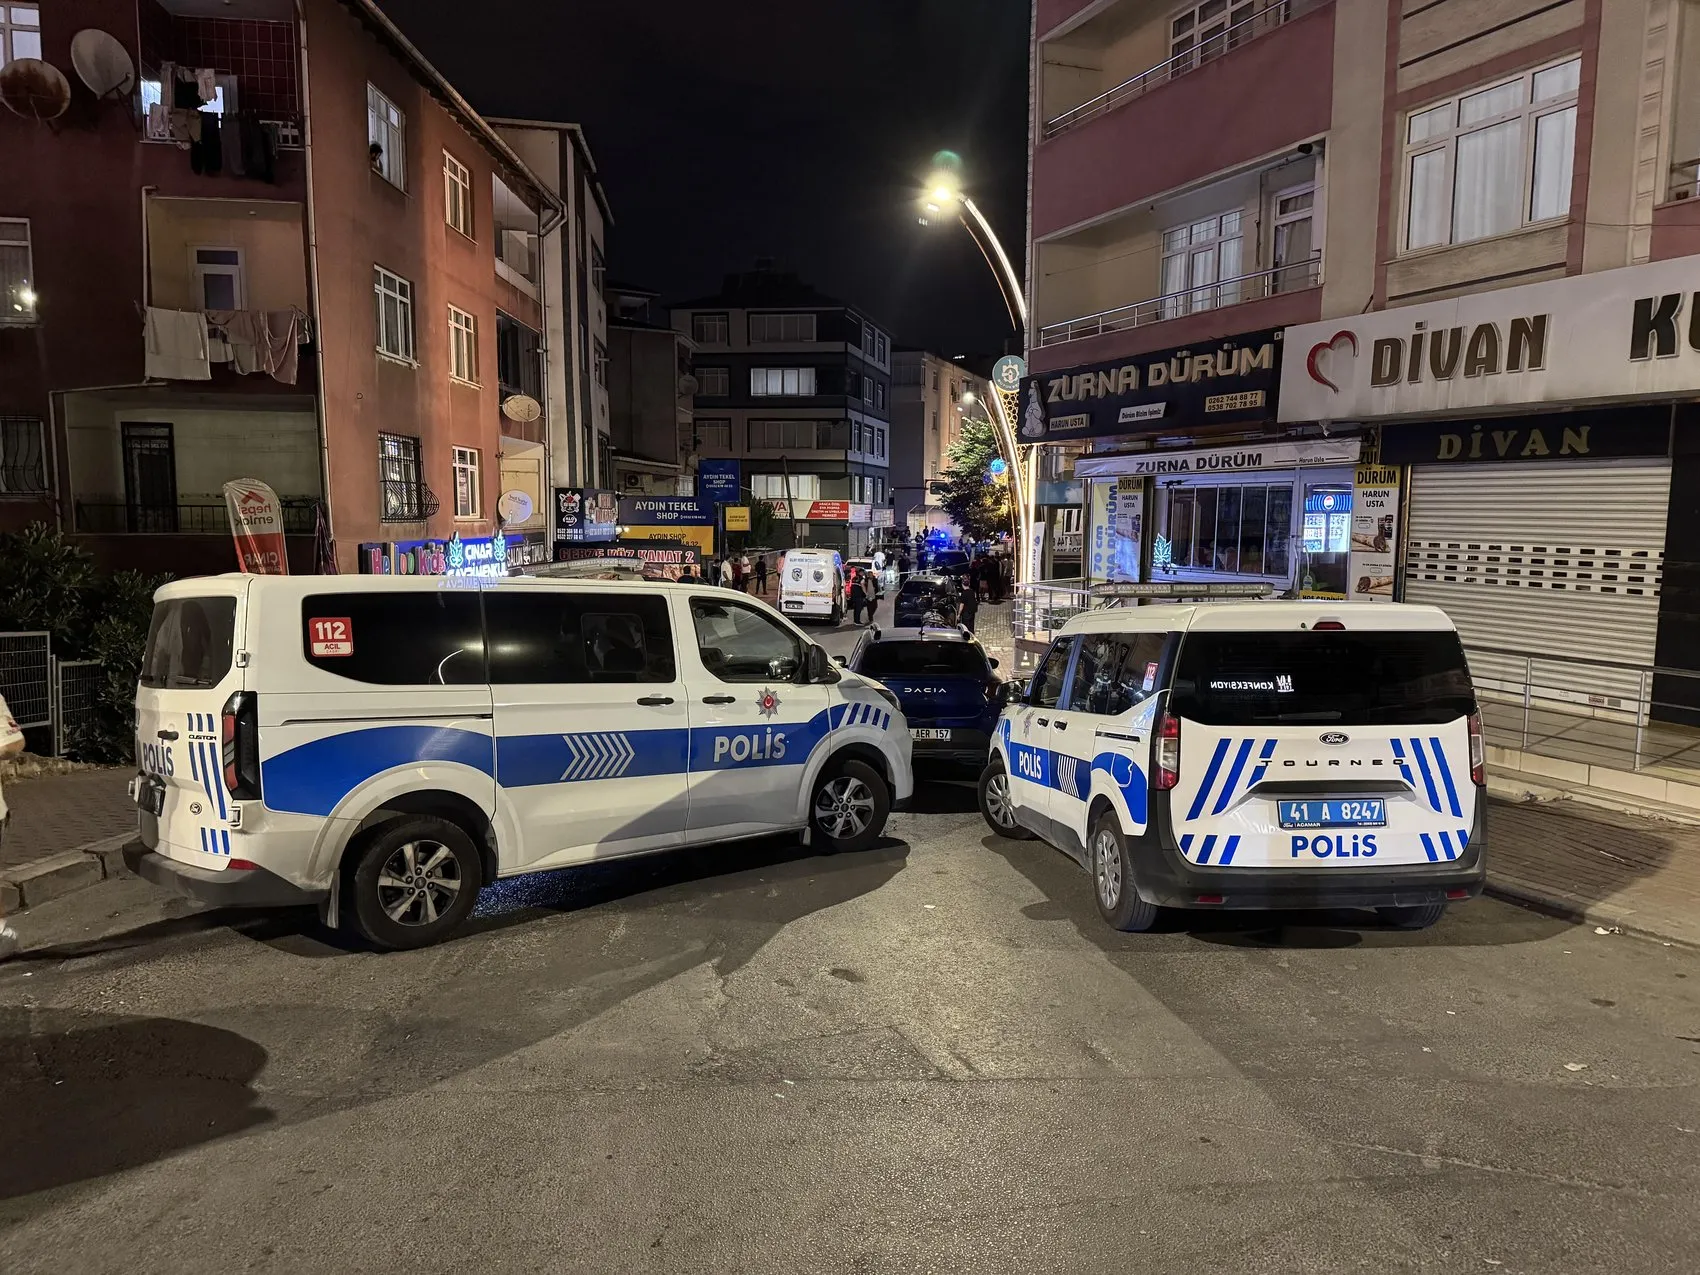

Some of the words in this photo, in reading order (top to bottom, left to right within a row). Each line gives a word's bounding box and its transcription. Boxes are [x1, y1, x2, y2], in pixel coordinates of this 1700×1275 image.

[1370, 314, 1552, 388] DİVAN
[1047, 365, 1140, 403] ZURNA
[1148, 343, 1274, 387] DÜRÜM
[1051, 418, 1069, 428] HARUN
[1070, 417, 1084, 426] USTA
[1436, 424, 1591, 460] DİVAN
[1135, 460, 1190, 474] ZURNA
[1196, 452, 1262, 470] DÜRÜM
[1119, 478, 1142, 490] DÜRÜM
[1358, 468, 1396, 484] DÜRÜM
[635, 502, 666, 510] AYDIN
[668, 502, 699, 511] TEKEL
[464, 542, 493, 562] ÇINAR
[638, 550, 682, 562] KANAT
[685, 550, 694, 563] 2
[1094, 552, 1103, 572] 70
[316, 622, 346, 640] 112
[916, 730, 930, 738] AER
[935, 730, 949, 738] 157
[714, 726, 786, 762] POLİS
[1290, 803, 1309, 820] 41
[1322, 803, 1330, 820] A
[1341, 802, 1380, 820] 8247
